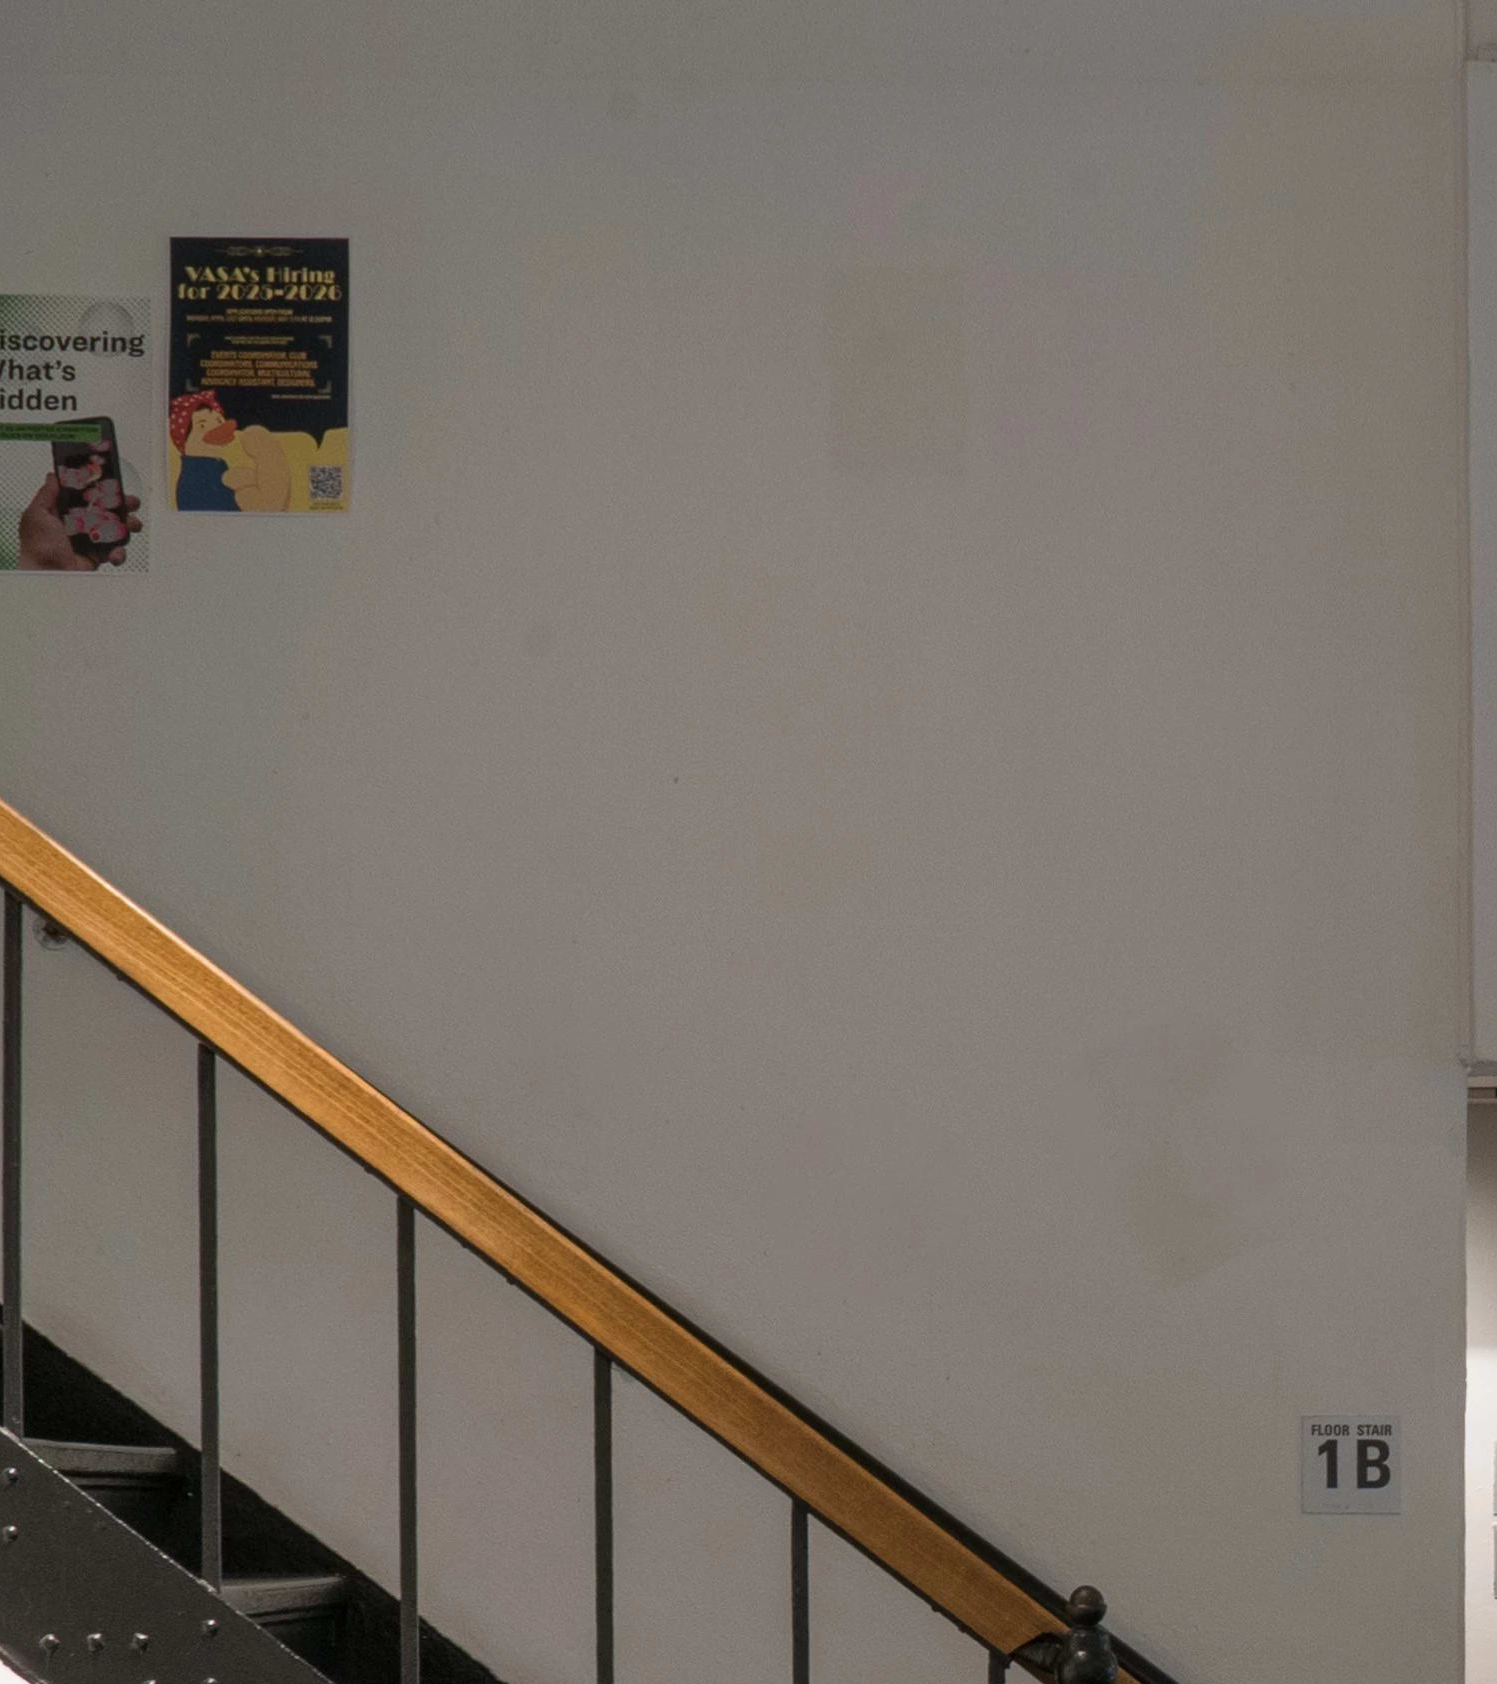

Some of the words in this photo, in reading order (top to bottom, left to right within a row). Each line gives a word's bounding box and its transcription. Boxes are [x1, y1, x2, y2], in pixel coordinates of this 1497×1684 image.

[184, 266, 261, 283] VASA's
[266, 266, 336, 284] Hiring
[178, 283, 211, 301] for
[216, 284, 343, 301] 2025-2026
[1310, 1424, 1350, 1437] FLOOR
[1356, 1424, 1393, 1437] STAIR
[1317, 1439, 1339, 1489] 1
[1356, 1439, 1391, 1489] B
